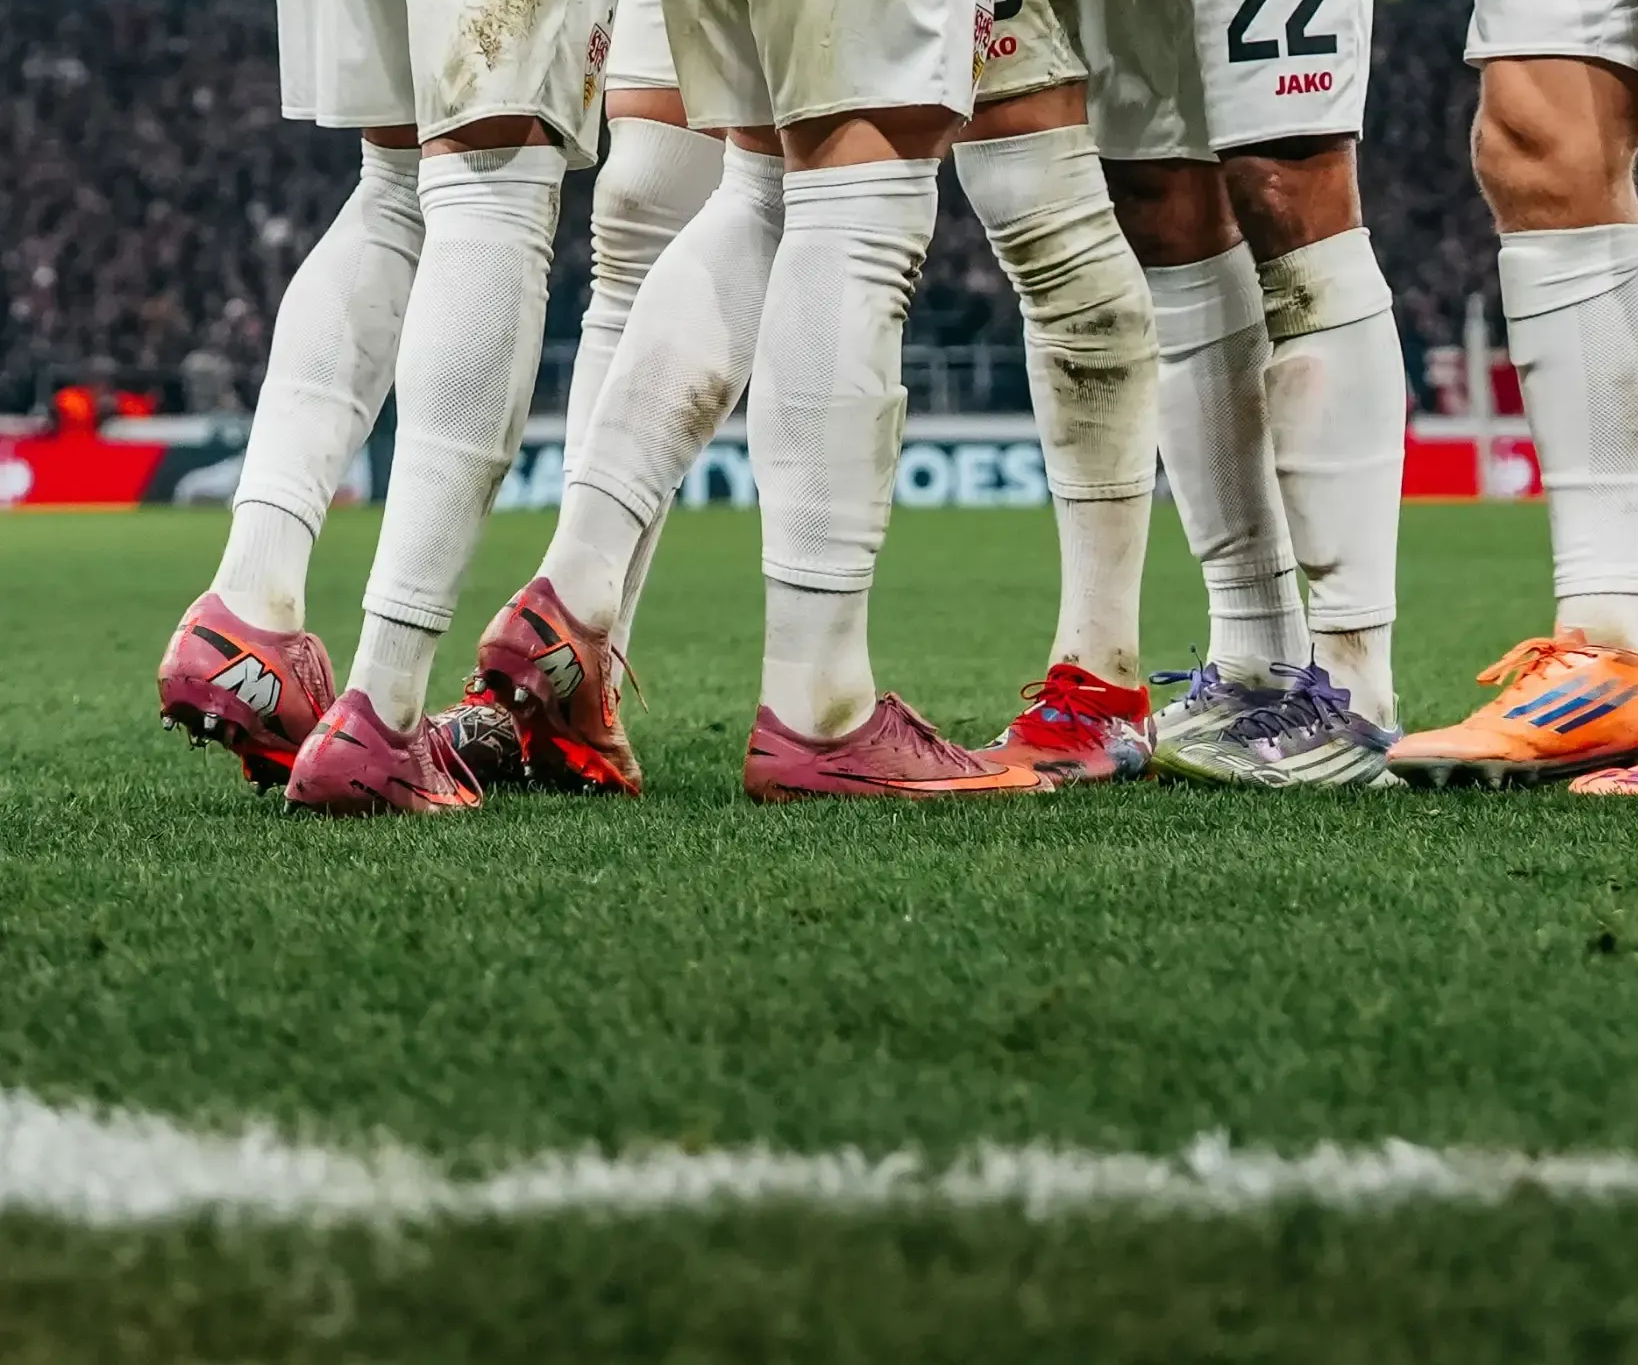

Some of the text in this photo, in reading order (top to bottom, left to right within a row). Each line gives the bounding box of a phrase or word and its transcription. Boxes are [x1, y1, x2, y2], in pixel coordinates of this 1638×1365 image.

[986, 36, 1017, 60] KO
[1275, 71, 1333, 96] JAKO
[894, 442, 1049, 509] OES
